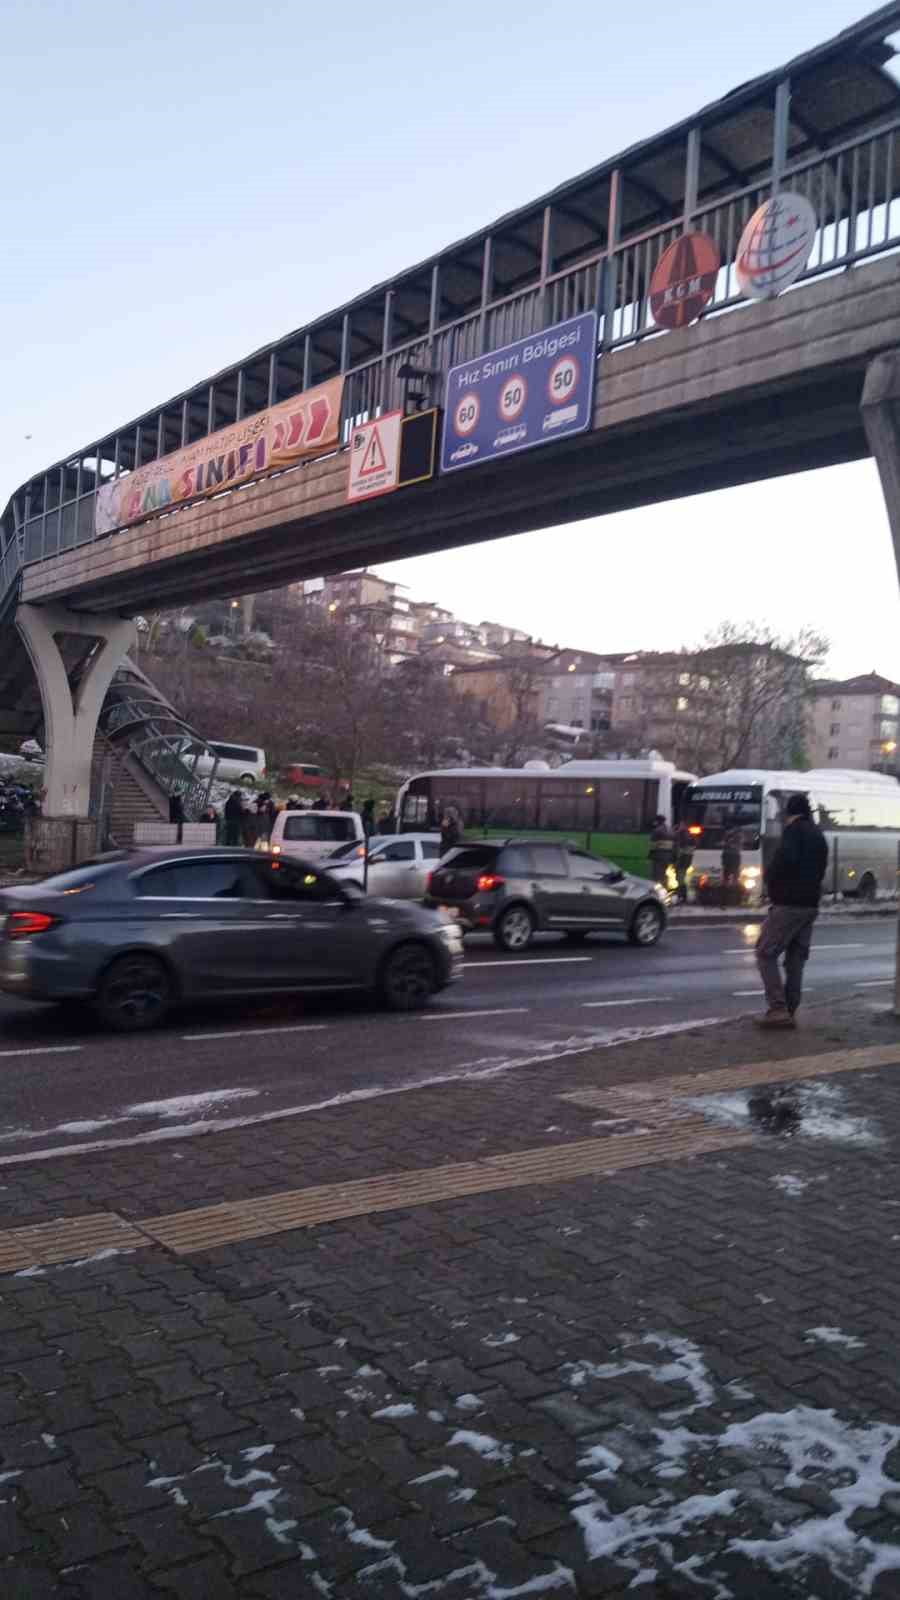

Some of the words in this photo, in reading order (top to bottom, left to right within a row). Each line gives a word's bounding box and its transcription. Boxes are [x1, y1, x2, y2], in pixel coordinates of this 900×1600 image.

[458, 369, 481, 387] Hız
[522, 325, 581, 363] Bölgesi
[553, 368, 574, 391] 50
[503, 387, 522, 408] 50
[459, 405, 476, 423] 60
